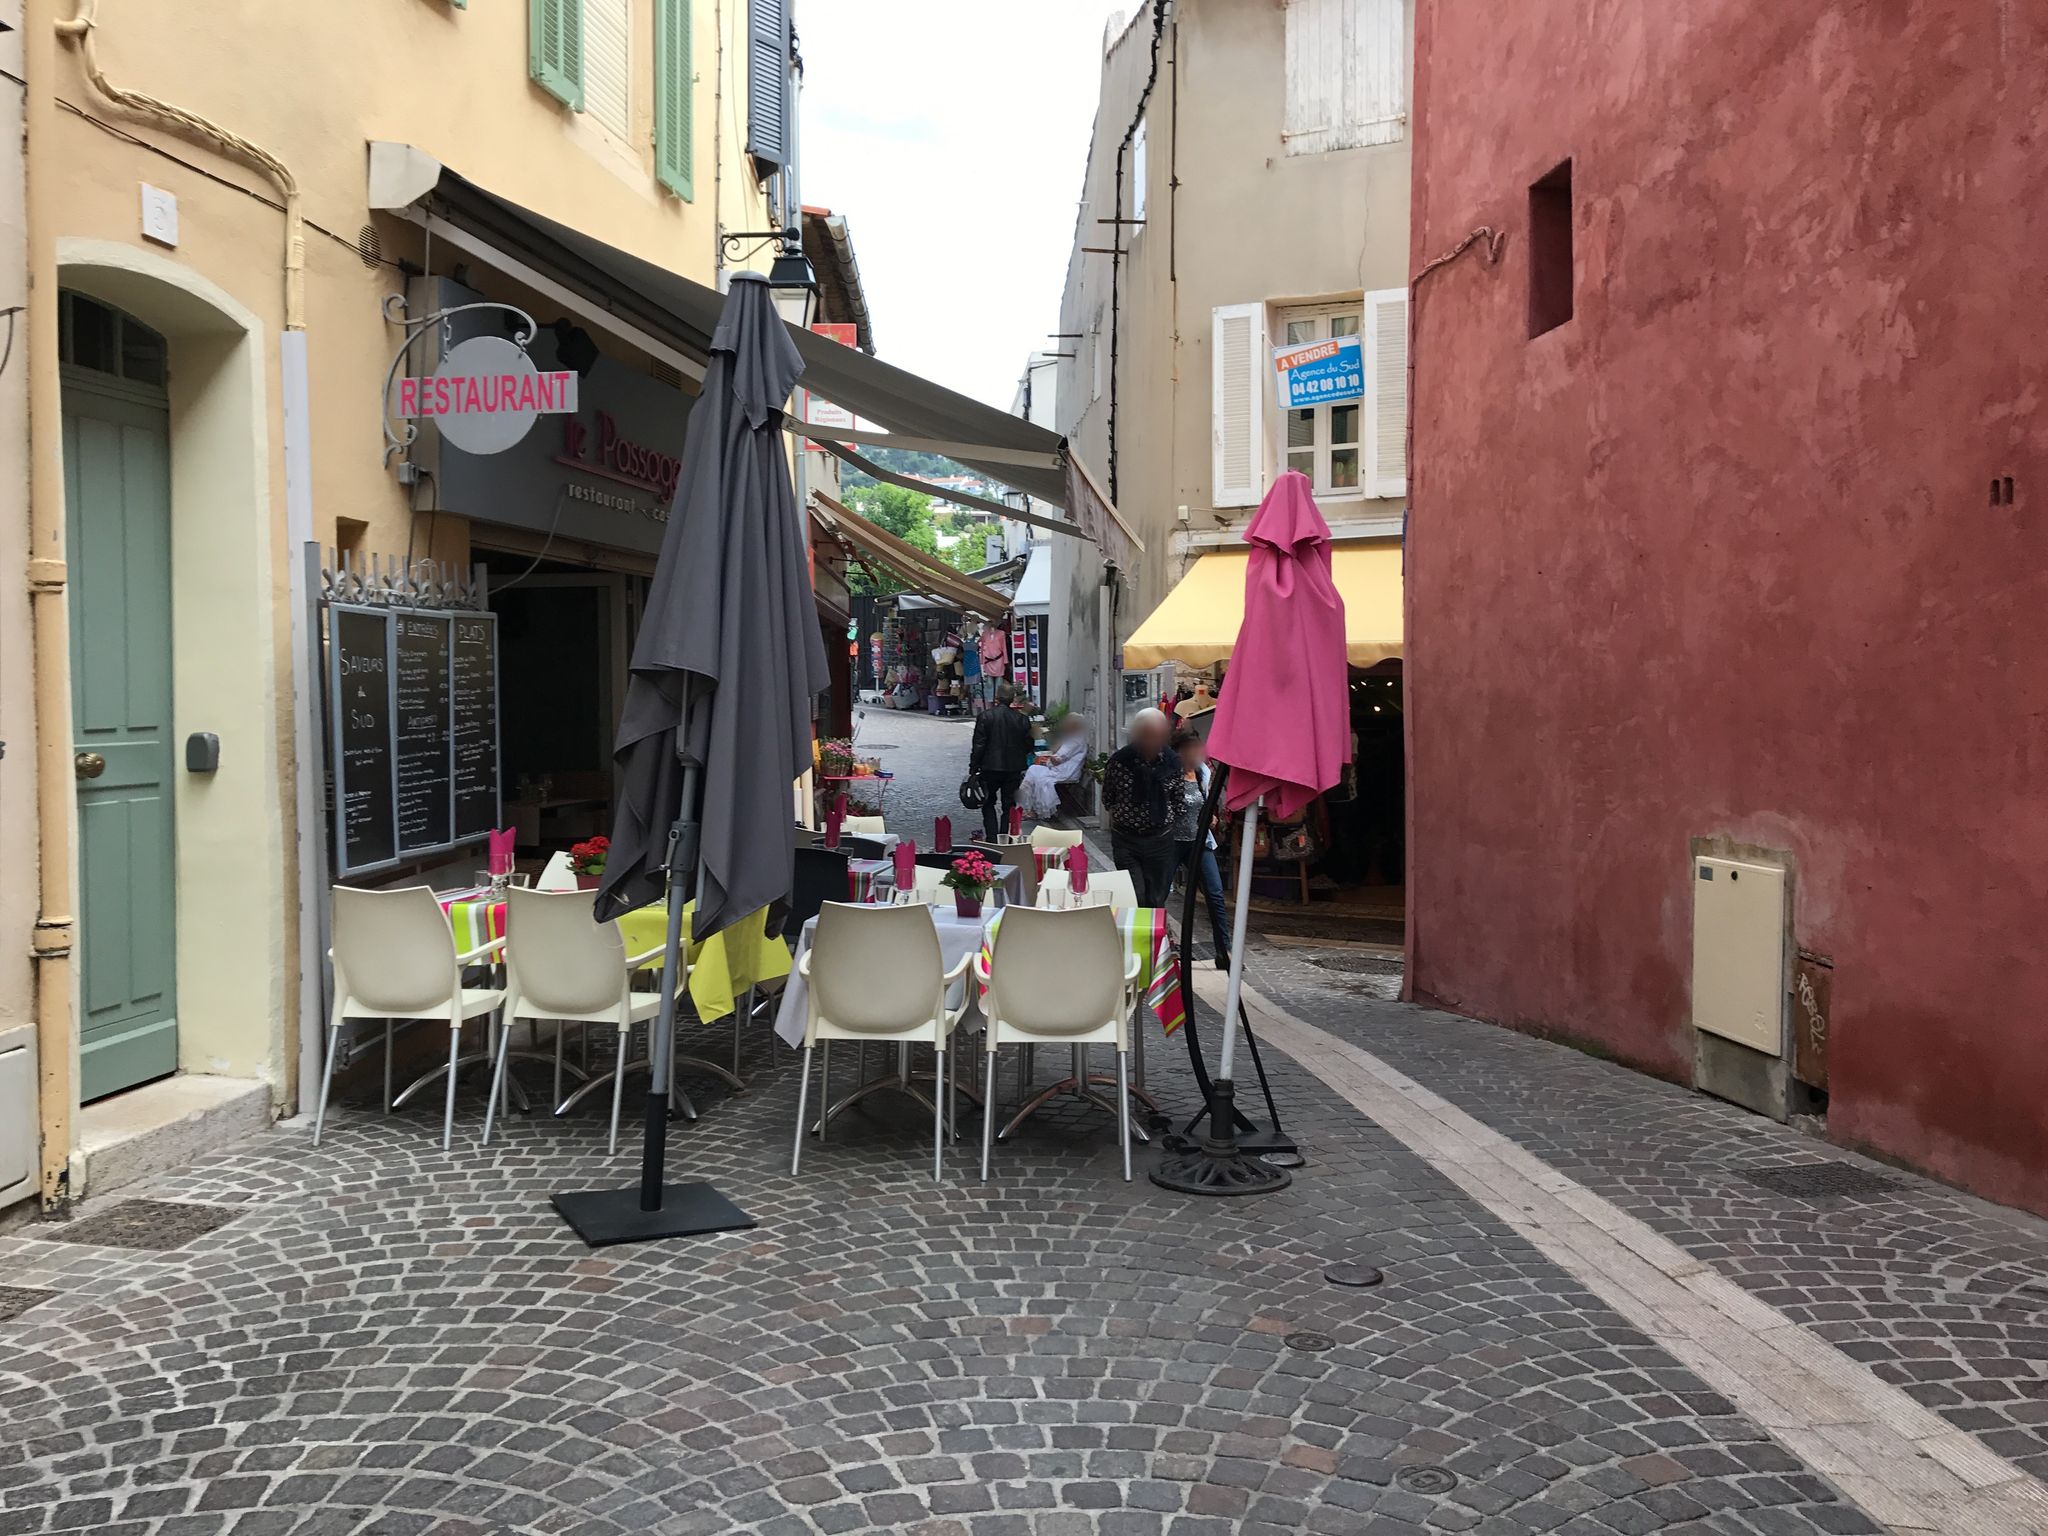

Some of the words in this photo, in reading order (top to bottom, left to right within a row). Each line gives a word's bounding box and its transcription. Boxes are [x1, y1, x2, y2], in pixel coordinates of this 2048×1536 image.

[1281, 358, 1289, 370] A
[1291, 343, 1336, 365] VENDRE
[1291, 368, 1326, 381] Agence
[1327, 362, 1338, 374] du
[1339, 358, 1360, 373] Sud
[401, 372, 570, 416] RESTAURANT
[1306, 380, 1320, 394] 42
[568, 482, 636, 514] restaurant
[459, 624, 485, 641] PLATS
